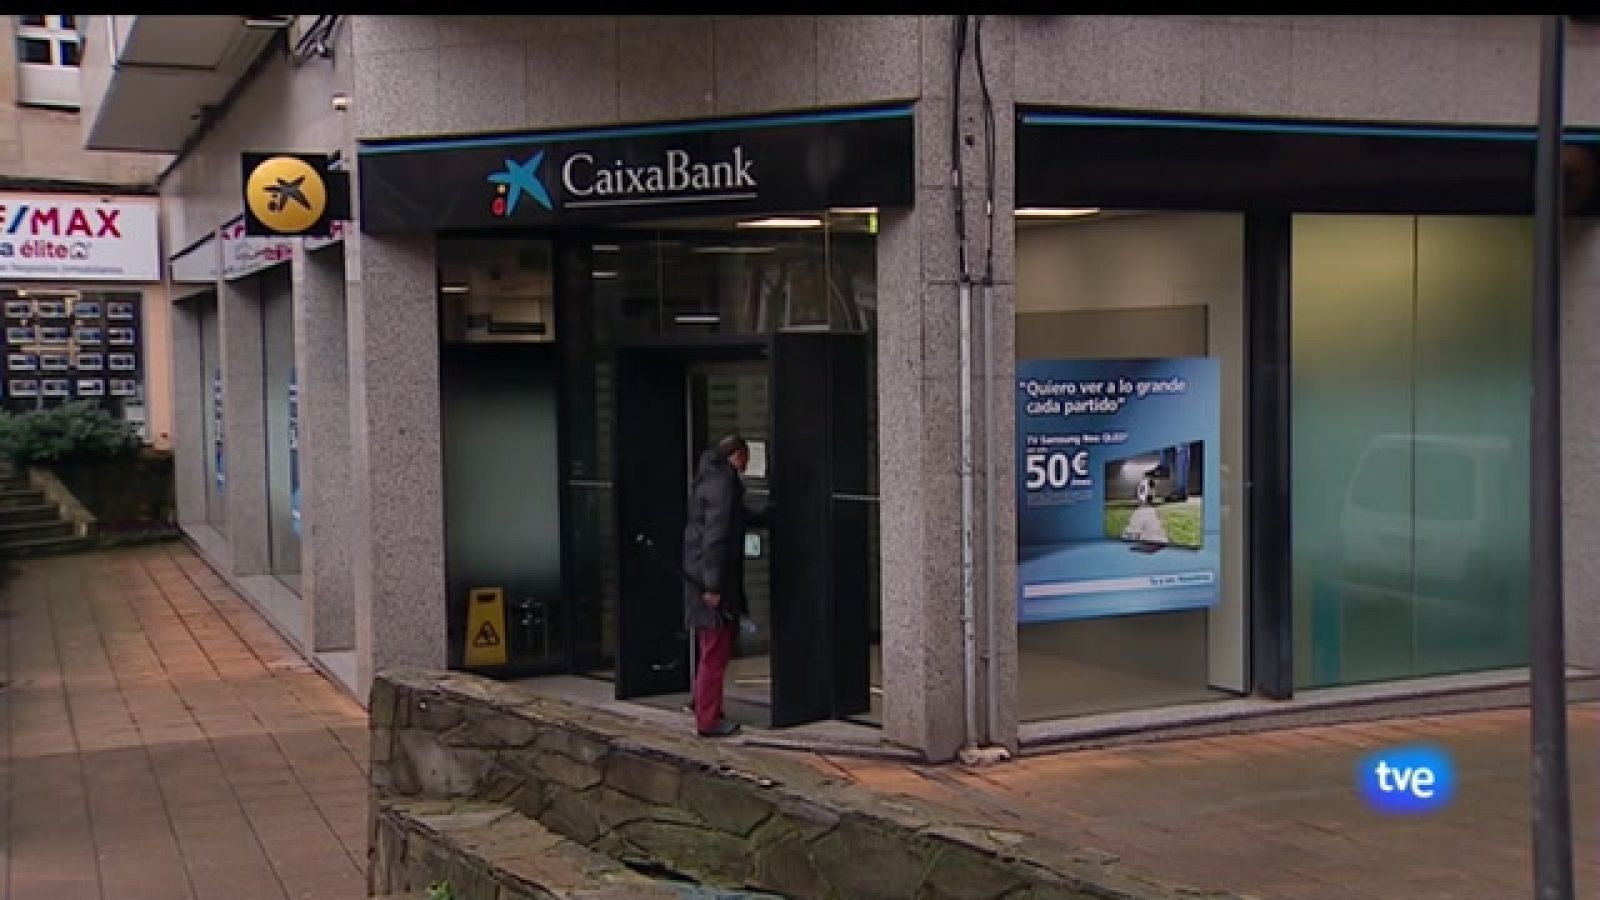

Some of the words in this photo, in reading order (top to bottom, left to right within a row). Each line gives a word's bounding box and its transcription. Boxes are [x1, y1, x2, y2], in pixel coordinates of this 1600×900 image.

[561, 145, 757, 195] CaixaBank
[0, 205, 121, 237] /MAX
[1080, 381, 1103, 394] ver
[1107, 382, 1115, 393] a
[1119, 377, 1133, 393] lo
[1136, 377, 1186, 396] grande
[1027, 398, 1060, 413] cada
[1026, 451, 1088, 489] 50€
